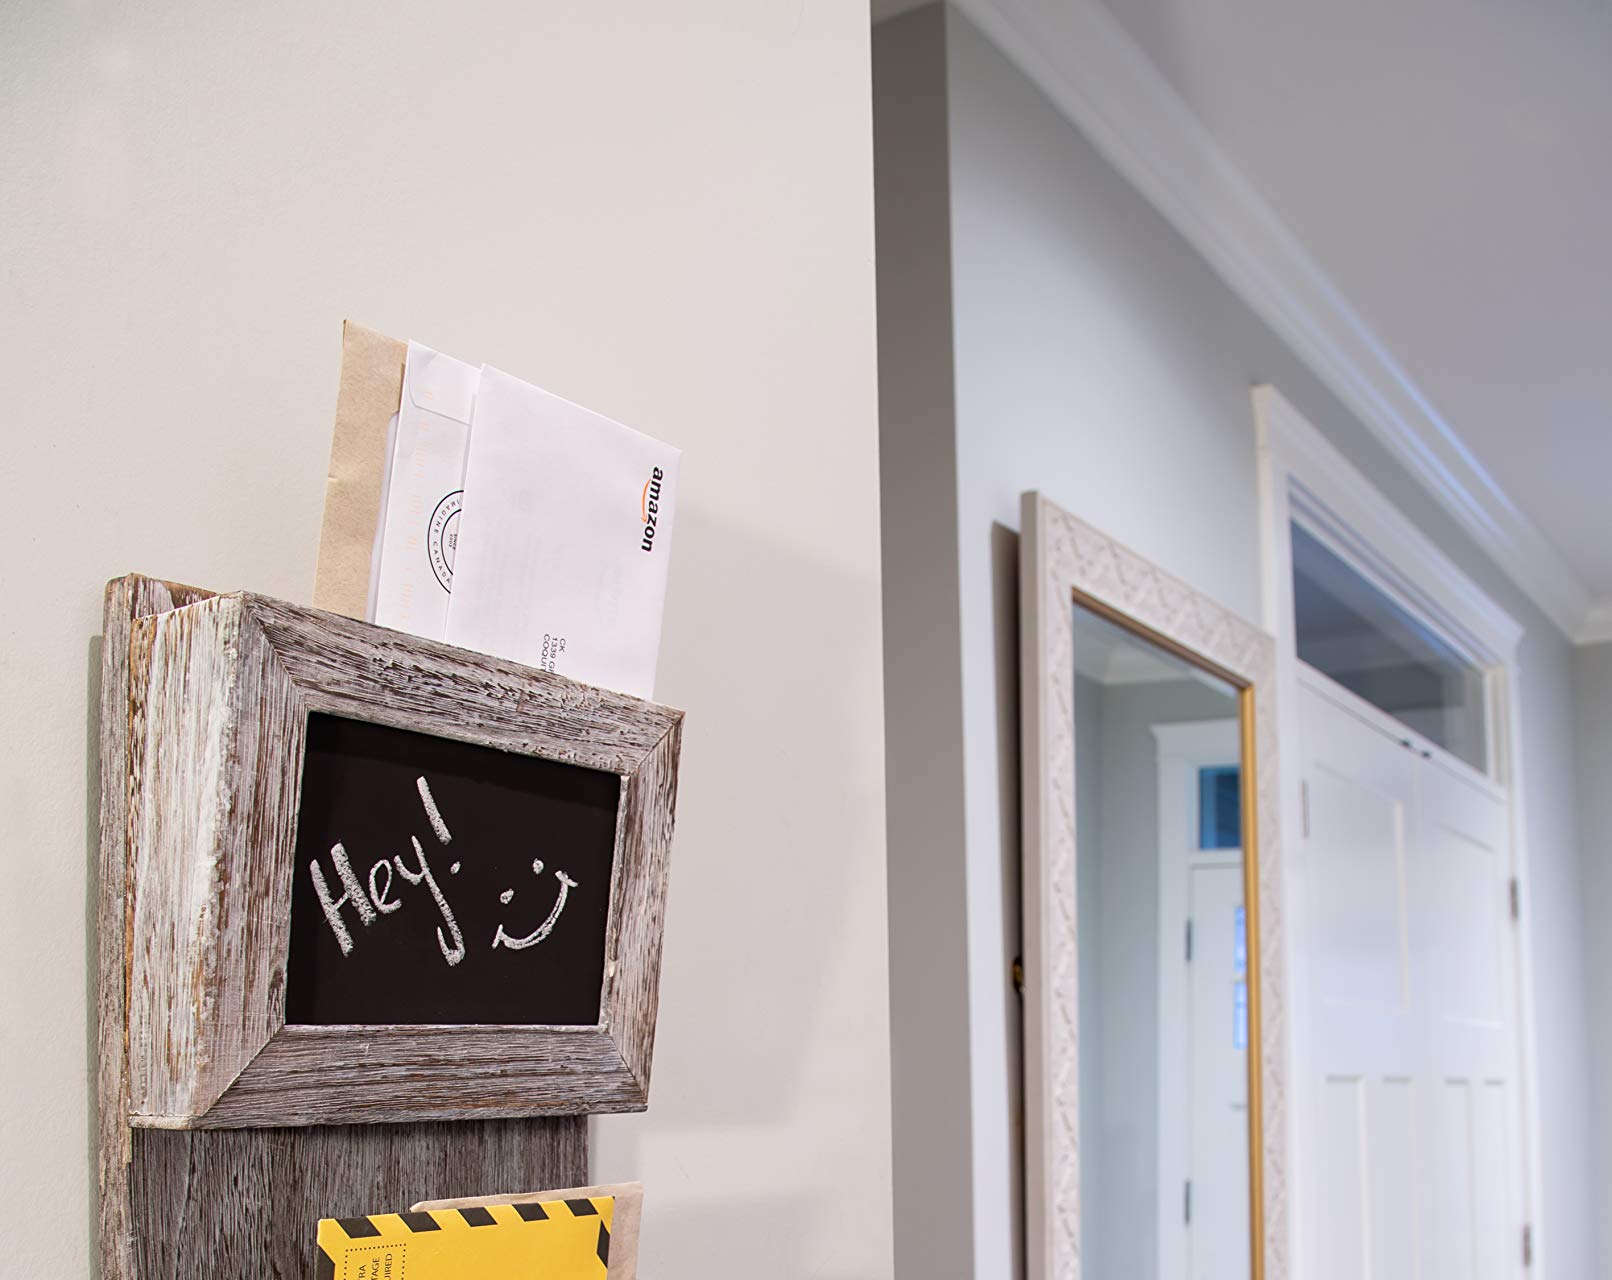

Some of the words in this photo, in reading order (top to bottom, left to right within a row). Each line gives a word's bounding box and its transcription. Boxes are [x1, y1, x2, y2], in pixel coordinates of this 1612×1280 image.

[641, 466, 663, 552] amazon
[433, 541, 451, 583] CANADA
[550, 637, 558, 659] 1339
[559, 638, 566, 653] CK
[310, 776, 465, 966] Hey!
